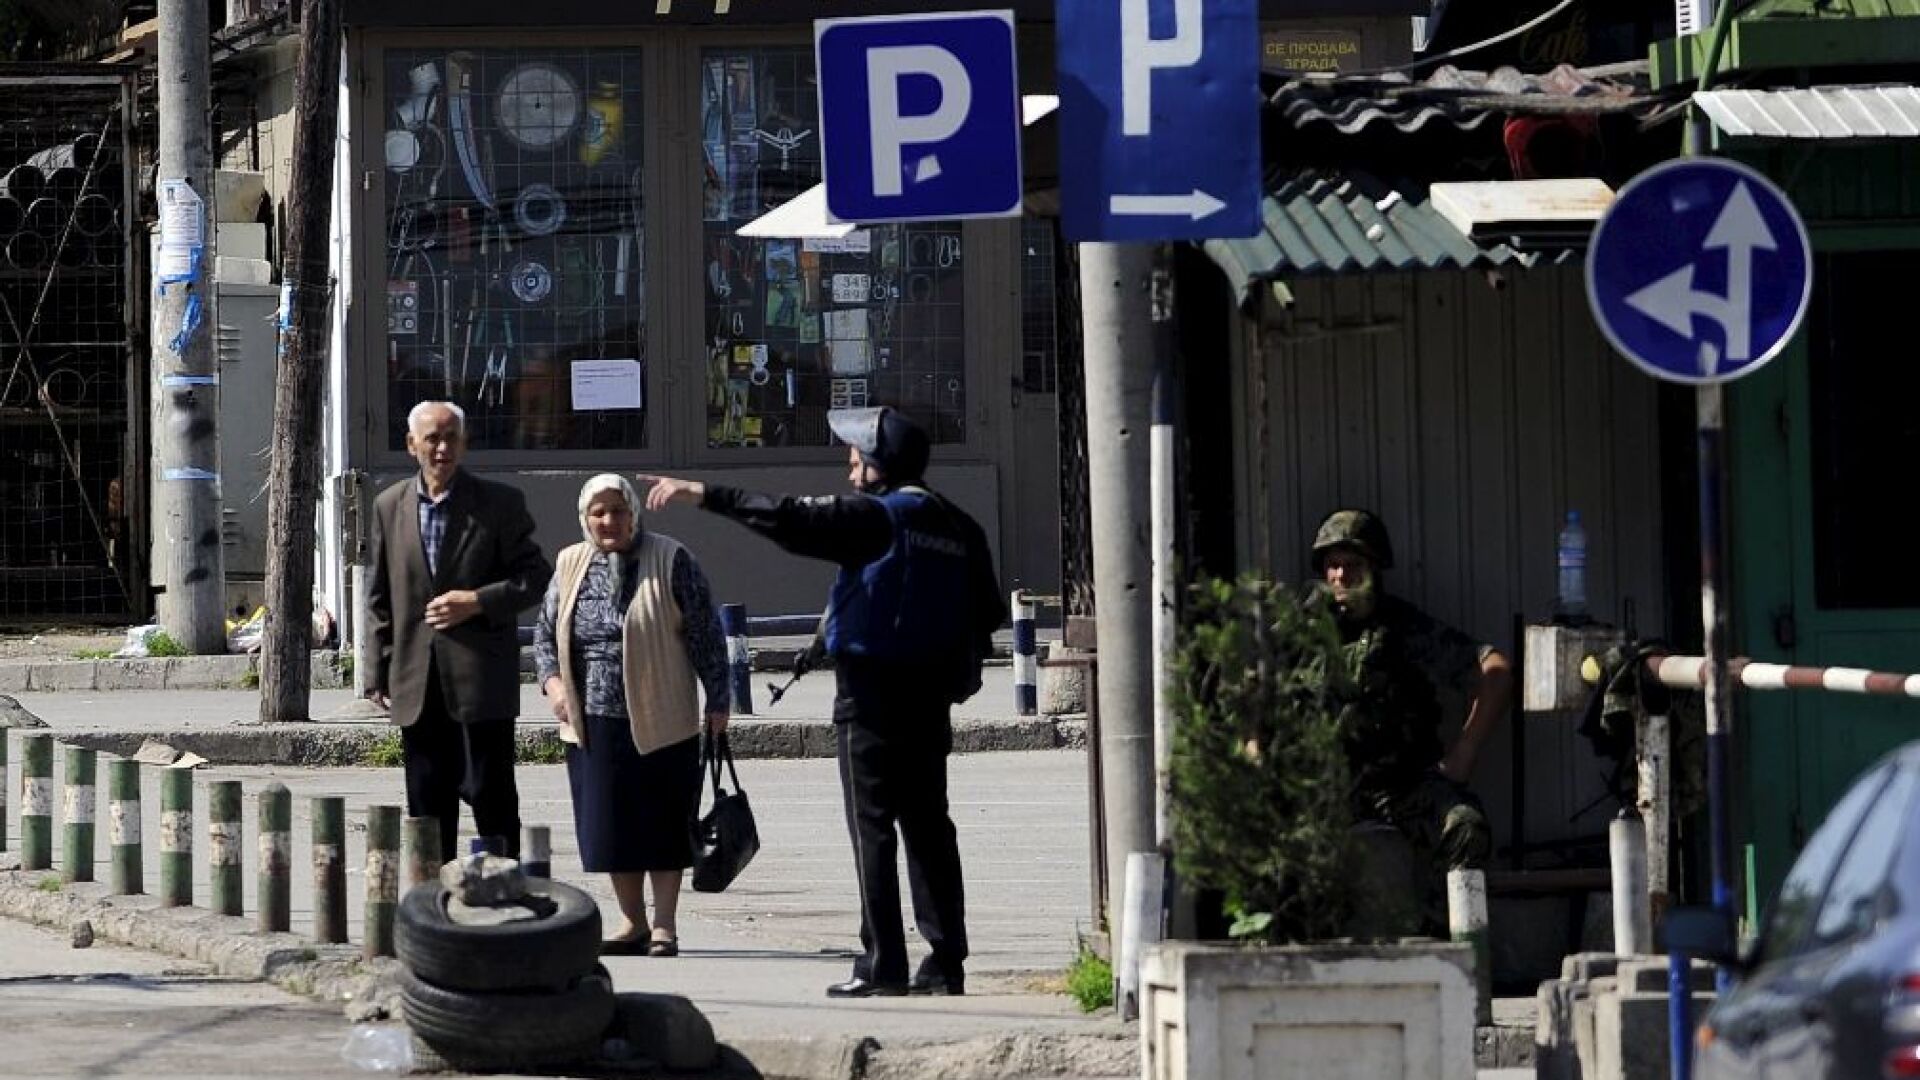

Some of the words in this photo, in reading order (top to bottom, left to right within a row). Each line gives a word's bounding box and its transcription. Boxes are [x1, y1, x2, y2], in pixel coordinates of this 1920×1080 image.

[1121, 0, 1203, 135] P
[1284, 58, 1339, 70] ЗГРАДА
[1289, 42, 1358, 56] ПРОДАВА
[866, 44, 972, 196] P
